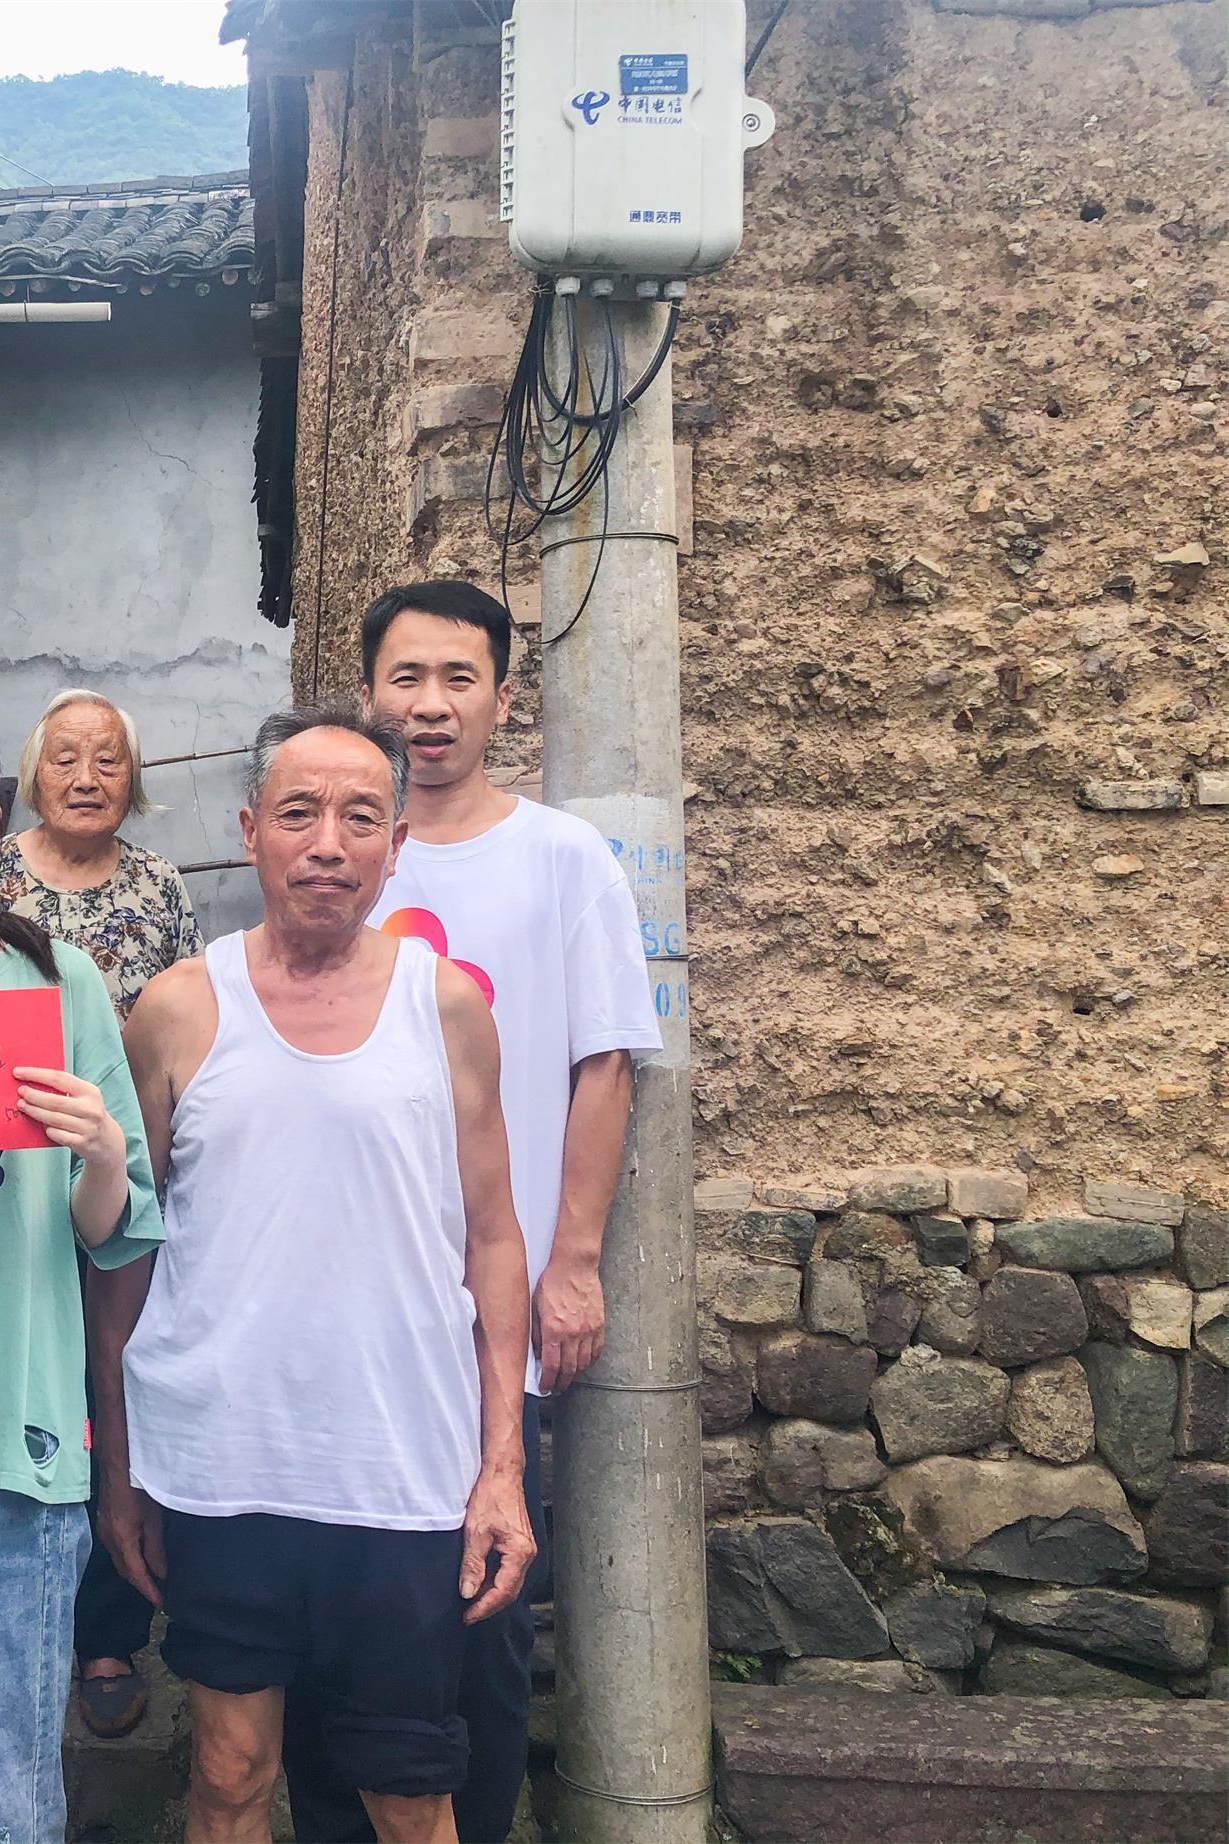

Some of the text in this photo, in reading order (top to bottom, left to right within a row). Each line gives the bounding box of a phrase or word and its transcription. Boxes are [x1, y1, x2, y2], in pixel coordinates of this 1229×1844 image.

[618, 95, 682, 114] 中国电信
[617, 116, 682, 125] CHINA TELECOM
[629, 210, 681, 224] 通鼎宽带
